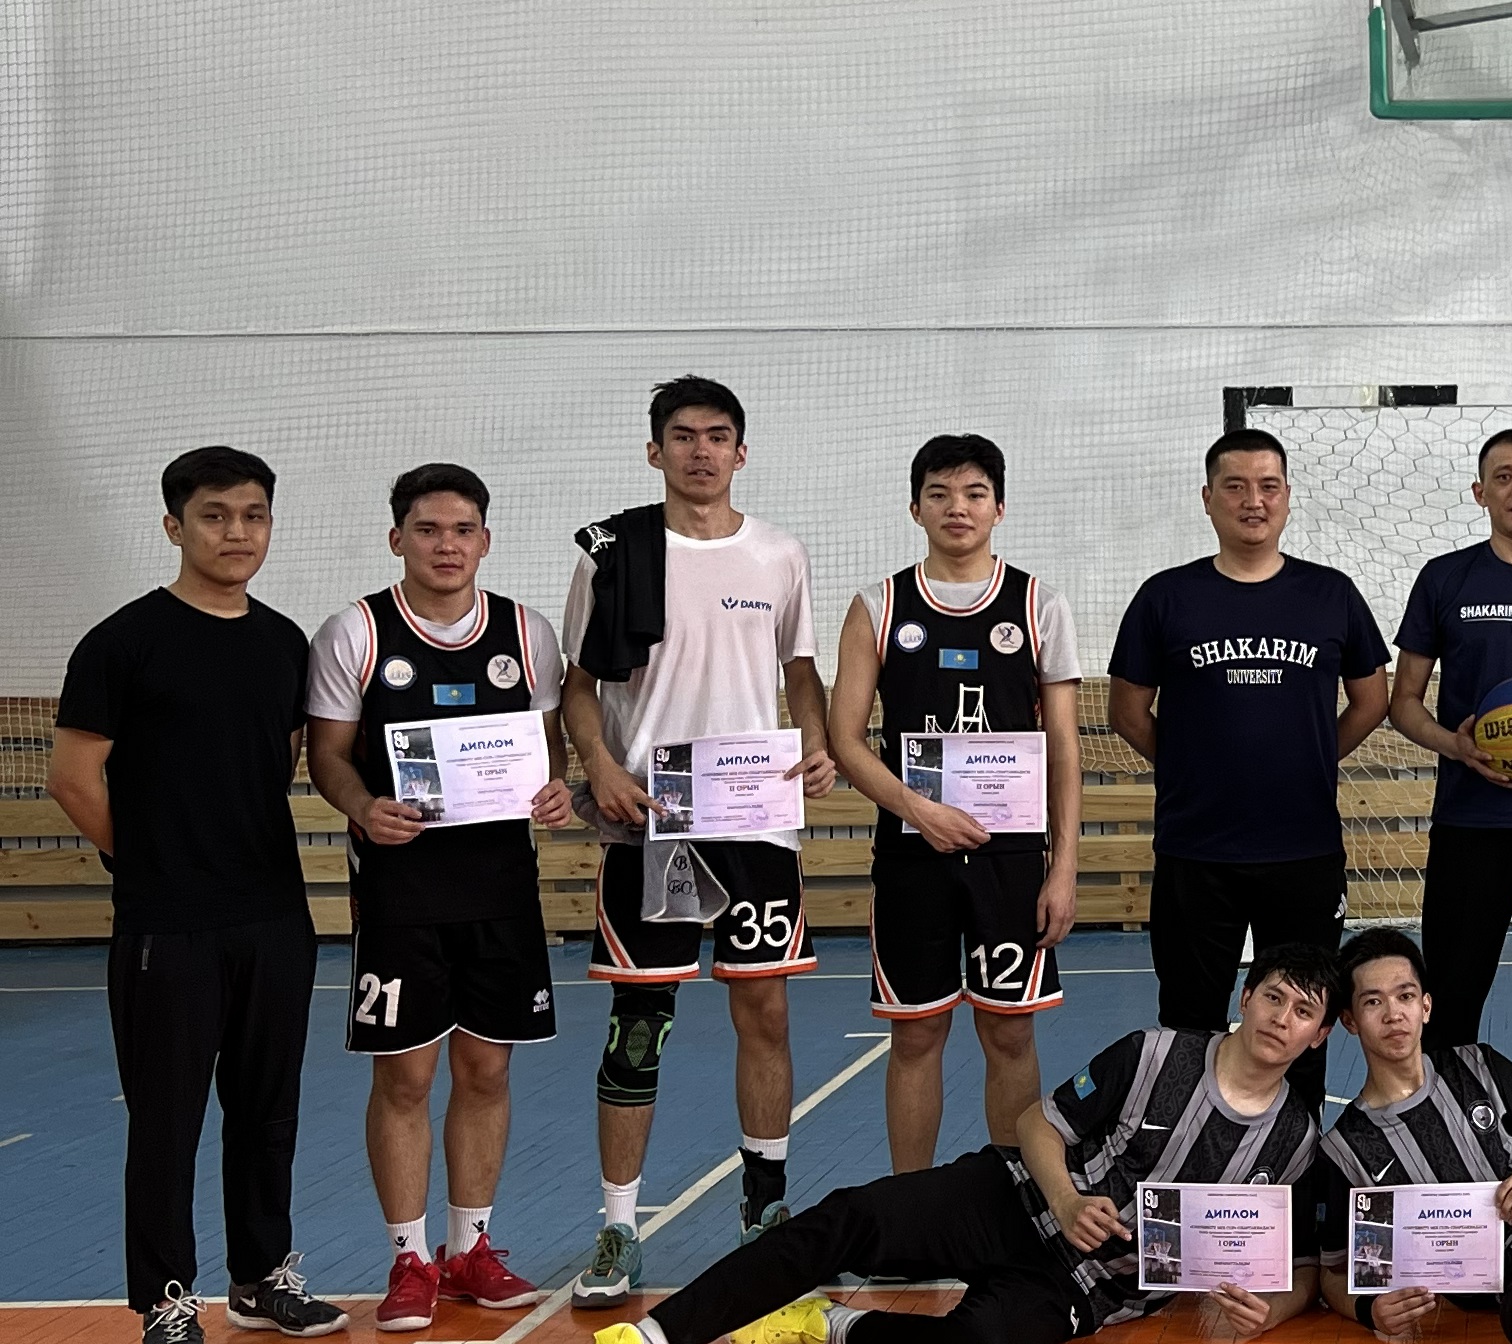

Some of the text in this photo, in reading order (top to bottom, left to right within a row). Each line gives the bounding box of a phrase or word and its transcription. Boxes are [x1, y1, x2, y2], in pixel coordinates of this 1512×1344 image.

[1190, 637, 1318, 668] SHAKARIM
[1226, 669, 1283, 684] UNIVERSITY
[460, 739, 514, 752] ДИПЛОМ
[716, 755, 770, 767] ДИПЛОМ
[966, 755, 1016, 765] ДИПЛОМ
[729, 899, 792, 950] 35
[970, 942, 1024, 989] 12
[355, 973, 402, 1028] 21
[1205, 1209, 1259, 1219] ДИПЛОМ
[1418, 1209, 1472, 1219] ДИПЛОМ
